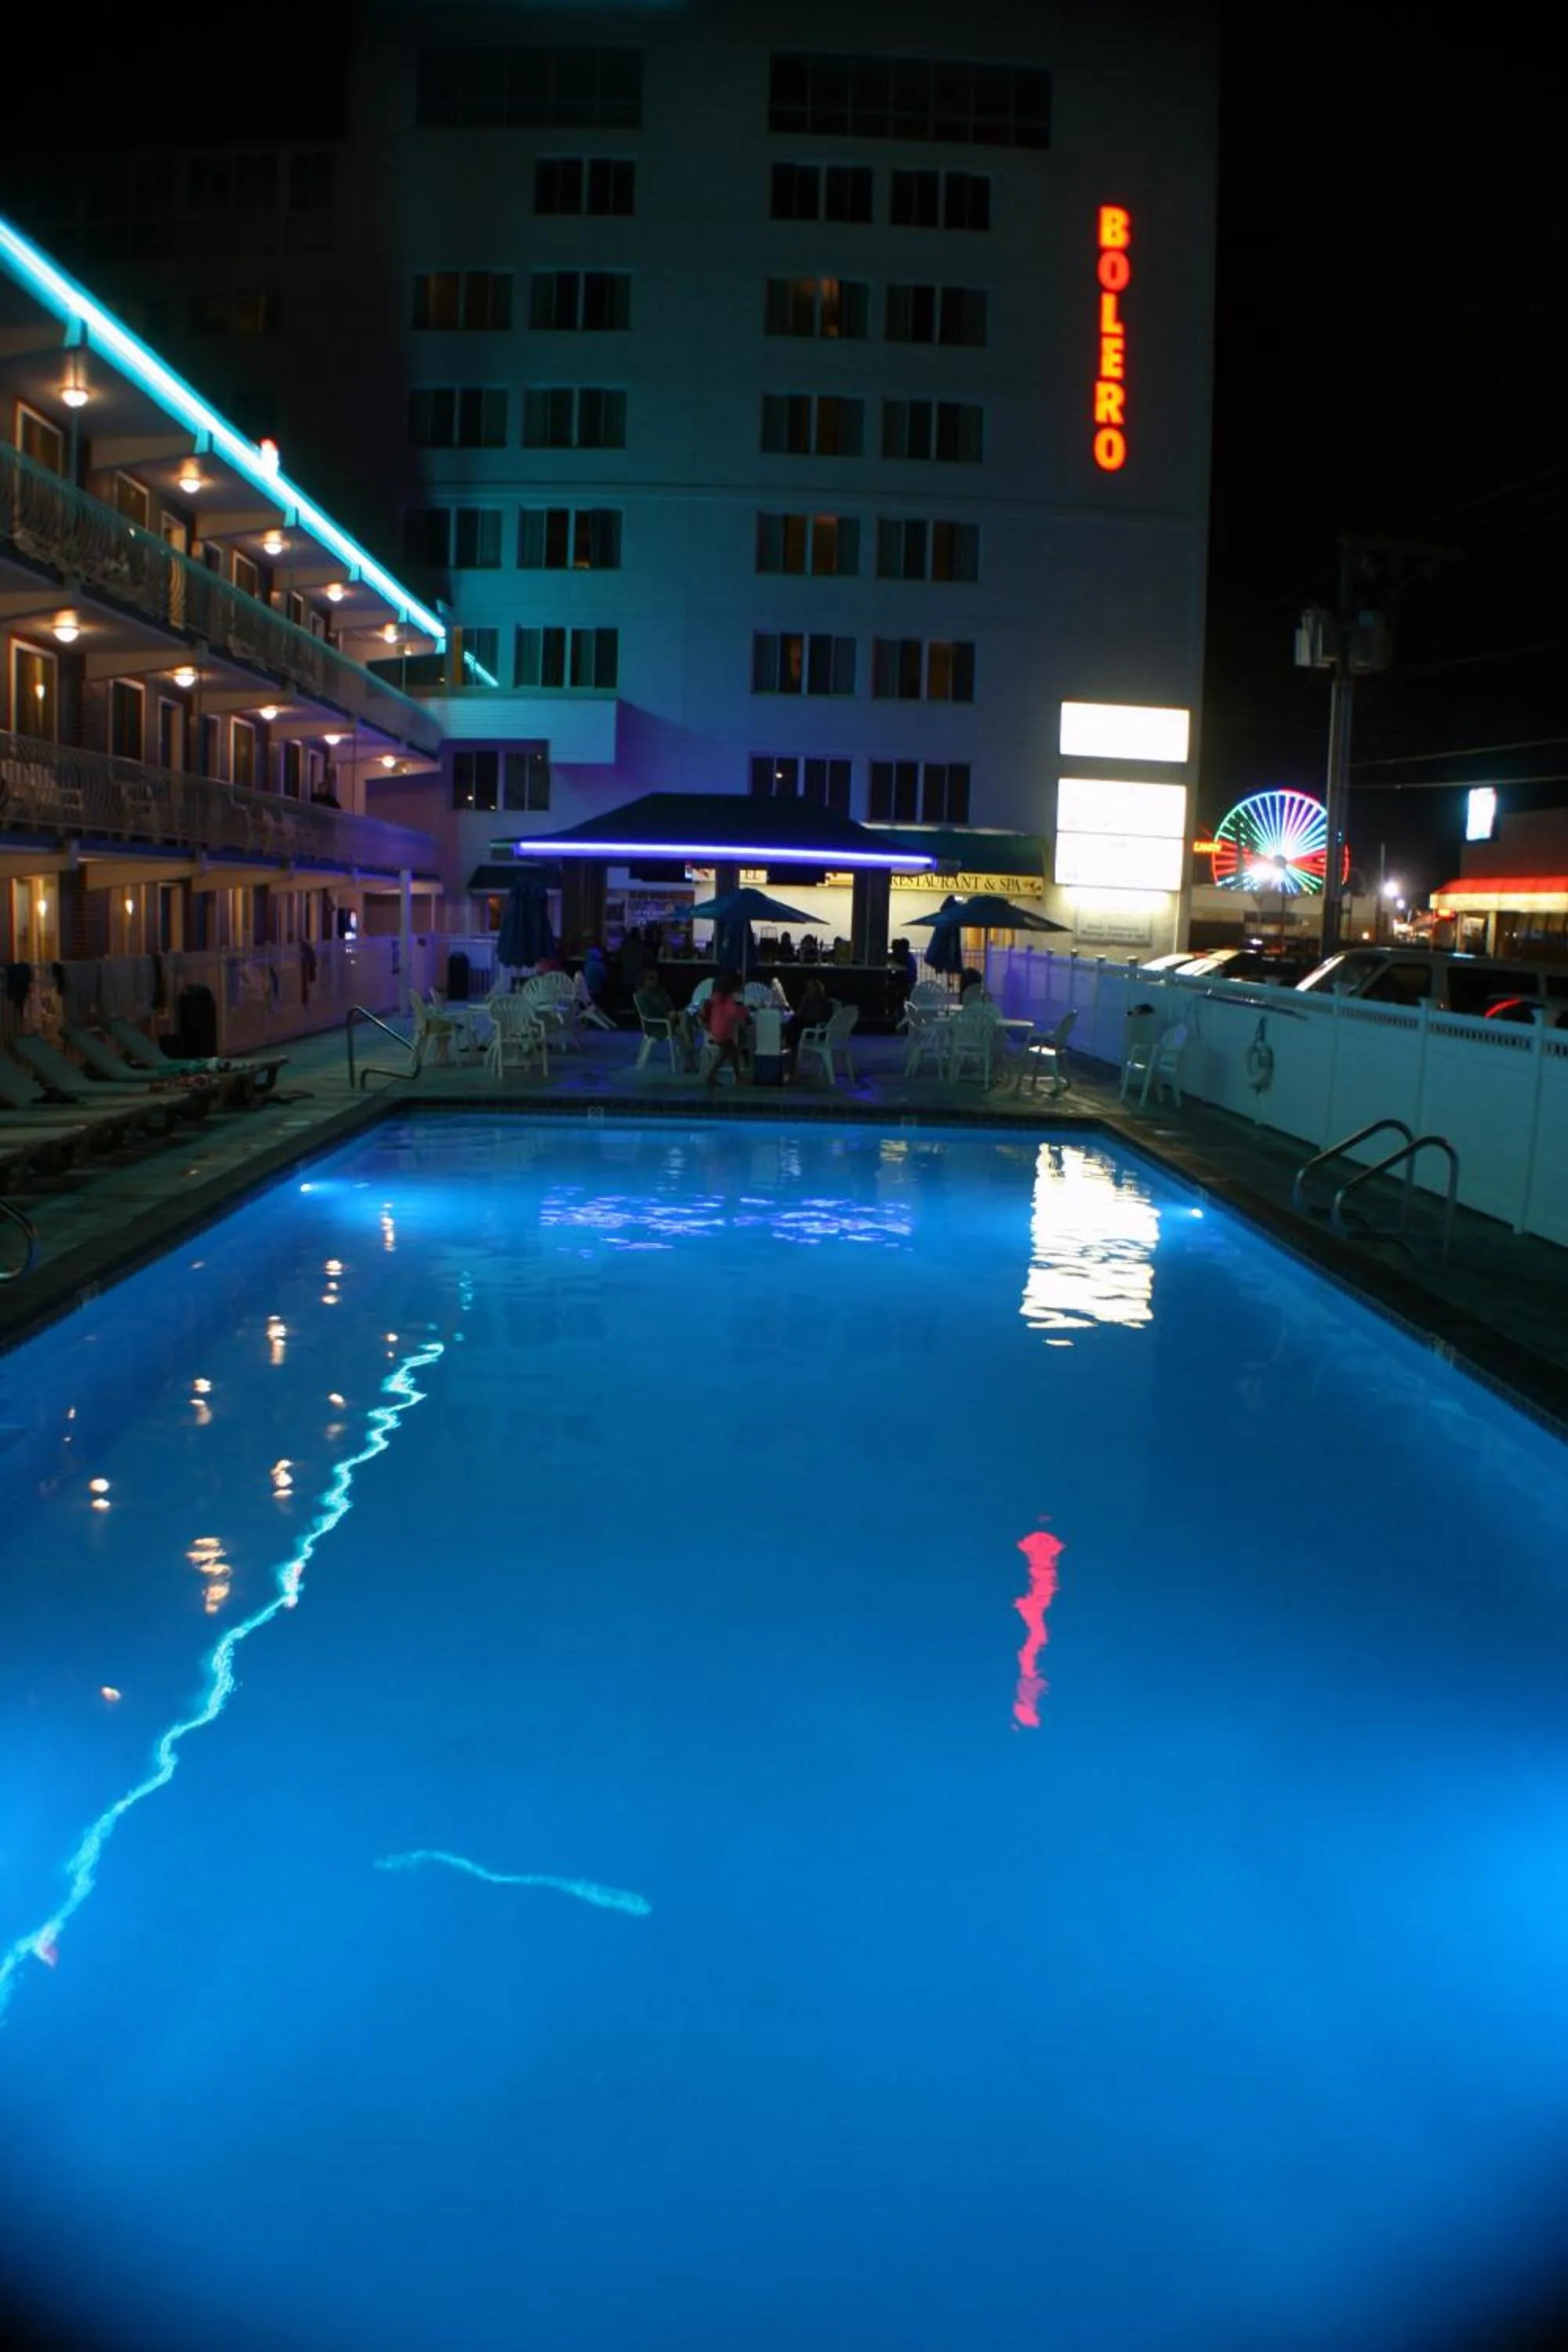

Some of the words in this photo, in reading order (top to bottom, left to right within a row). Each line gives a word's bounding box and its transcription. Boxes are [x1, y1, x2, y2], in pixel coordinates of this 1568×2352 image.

[1094, 205, 1130, 470] BOLERO
[984, 877, 996, 891] &
[1000, 877, 1021, 892] SPA
